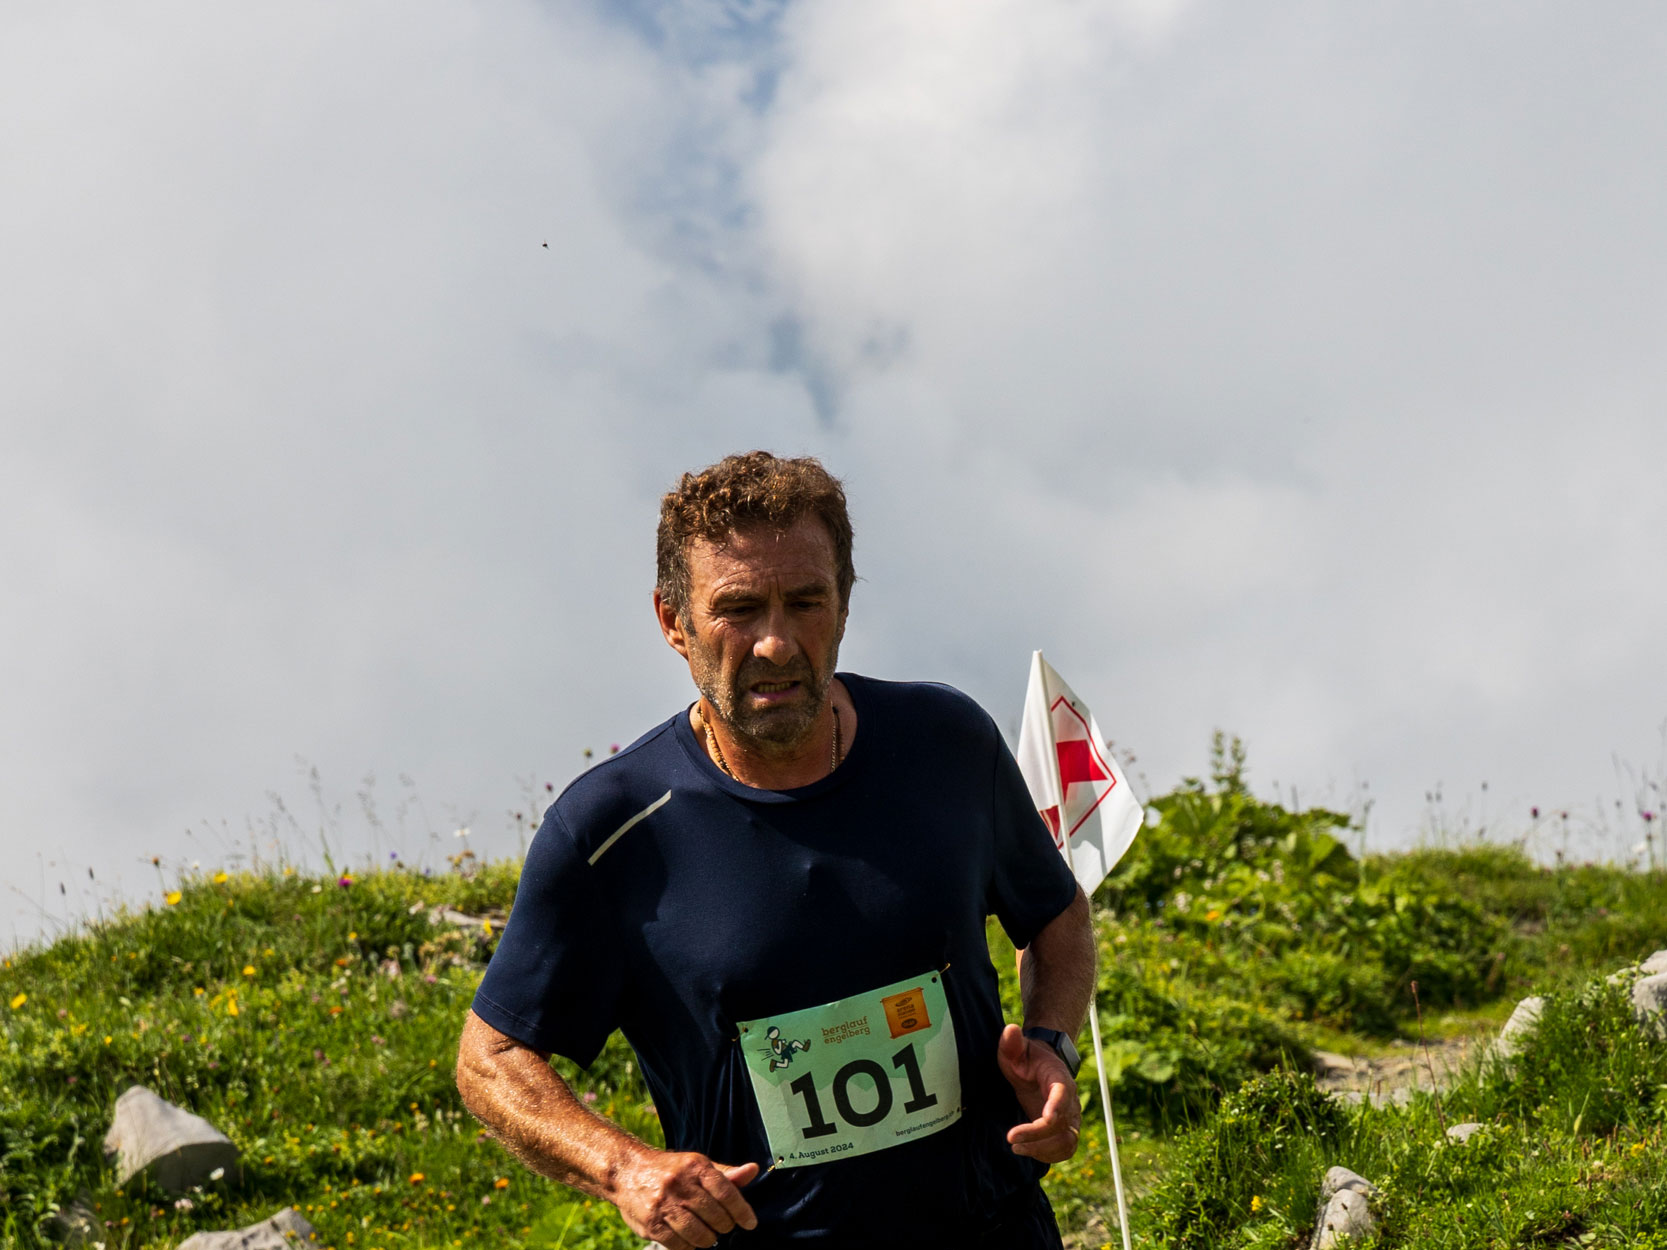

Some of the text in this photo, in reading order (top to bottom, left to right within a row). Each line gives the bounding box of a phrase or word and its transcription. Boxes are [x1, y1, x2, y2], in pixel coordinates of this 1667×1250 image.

[821, 1016, 867, 1036] berglauf
[824, 1027, 870, 1044] engelberg
[790, 1043, 938, 1139] 101
[789, 1142, 854, 1160] 4. August 2024
